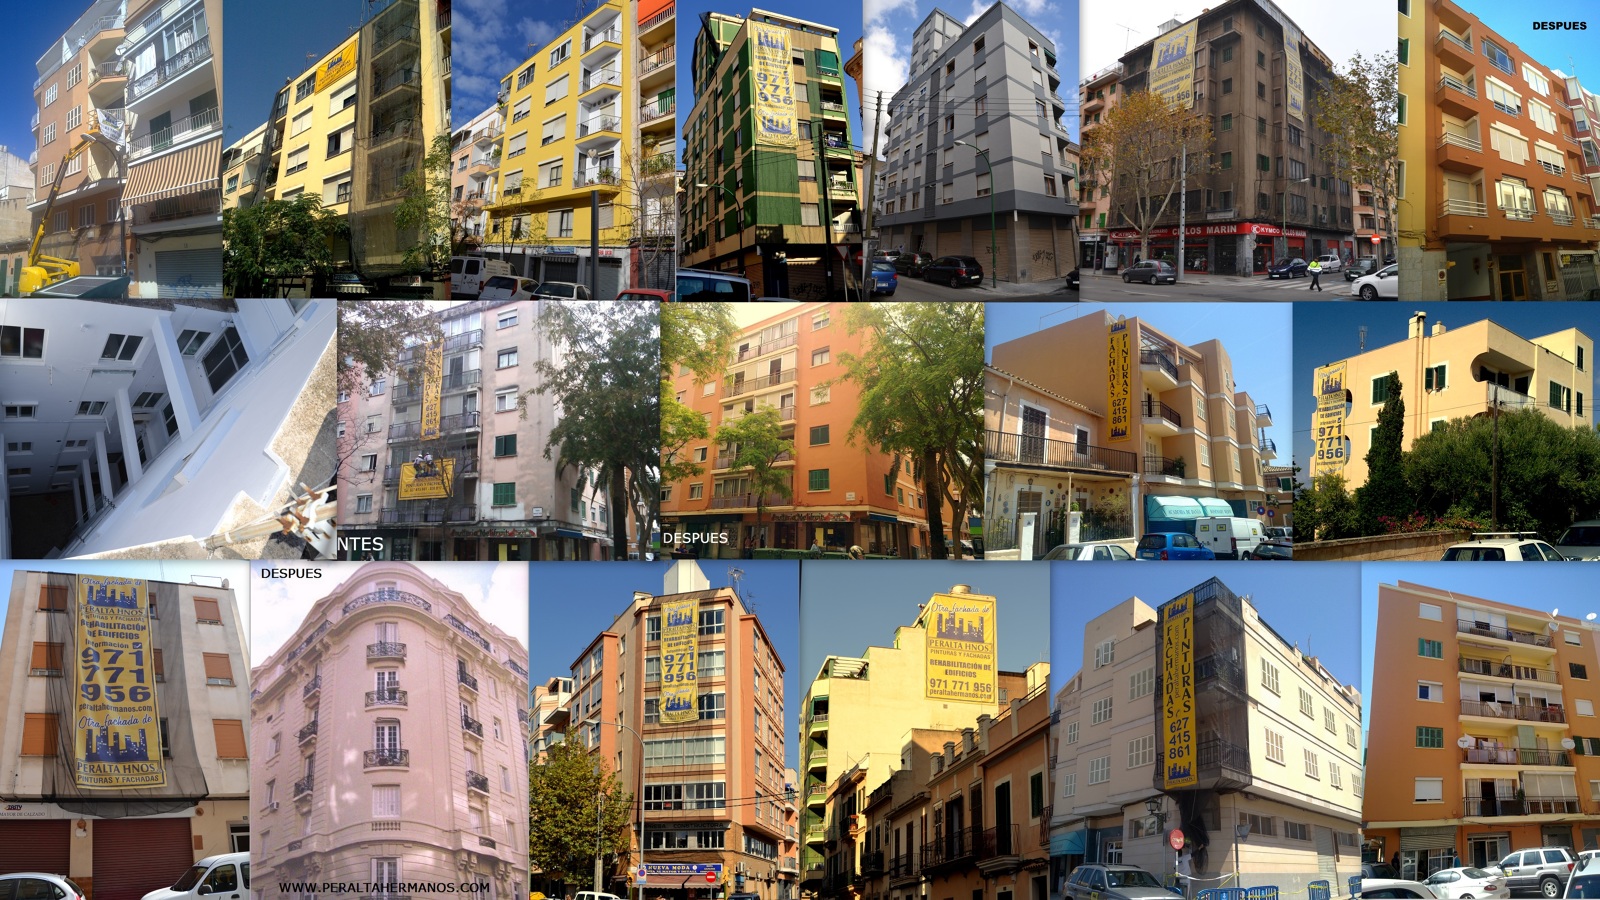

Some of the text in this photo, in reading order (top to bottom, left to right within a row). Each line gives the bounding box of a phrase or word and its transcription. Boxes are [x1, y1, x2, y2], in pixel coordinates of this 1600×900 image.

[756, 71, 790, 86] 971
[757, 81, 791, 95] 771
[757, 91, 794, 106] 956
[1176, 89, 1190, 102] 956
[1172, 227, 1202, 236] CILOS
[1206, 225, 1237, 234] MARIN
[1112, 397, 1127, 408] 627
[1112, 406, 1128, 415] 415
[1112, 415, 1127, 425] 861
[1318, 424, 1342, 437] 971
[1318, 436, 1342, 448] 771
[1317, 447, 1344, 460] 956
[80, 604, 115, 614] PERALTA
[80, 619, 147, 632] REHABILITACIÓN
[87, 629, 140, 640] DE EDIFICIOS
[929, 639, 963, 650] PERALTA
[81, 646, 144, 667] 971
[663, 651, 694, 664] 971
[664, 661, 694, 673] 771
[929, 658, 983, 671] REHABILITACIÓN
[1165, 616, 1192, 719] FACHADAS PINTURAS
[81, 664, 145, 684] 771
[663, 671, 696, 683] 956
[944, 669, 977, 679] EDIFICIOS
[929, 677, 992, 693] 971 771 956
[80, 683, 151, 703] 956
[78, 702, 153, 713] peraltahermanos.com
[78, 713, 153, 730] Otra fachada de
[1169, 716, 1190, 734] 627
[1168, 730, 1191, 746] 415
[1168, 744, 1191, 760] 861
[77, 761, 120, 774] PERALTA
[77, 774, 113, 784] PINTURAS
[121, 774, 159, 783] FACHADAS
